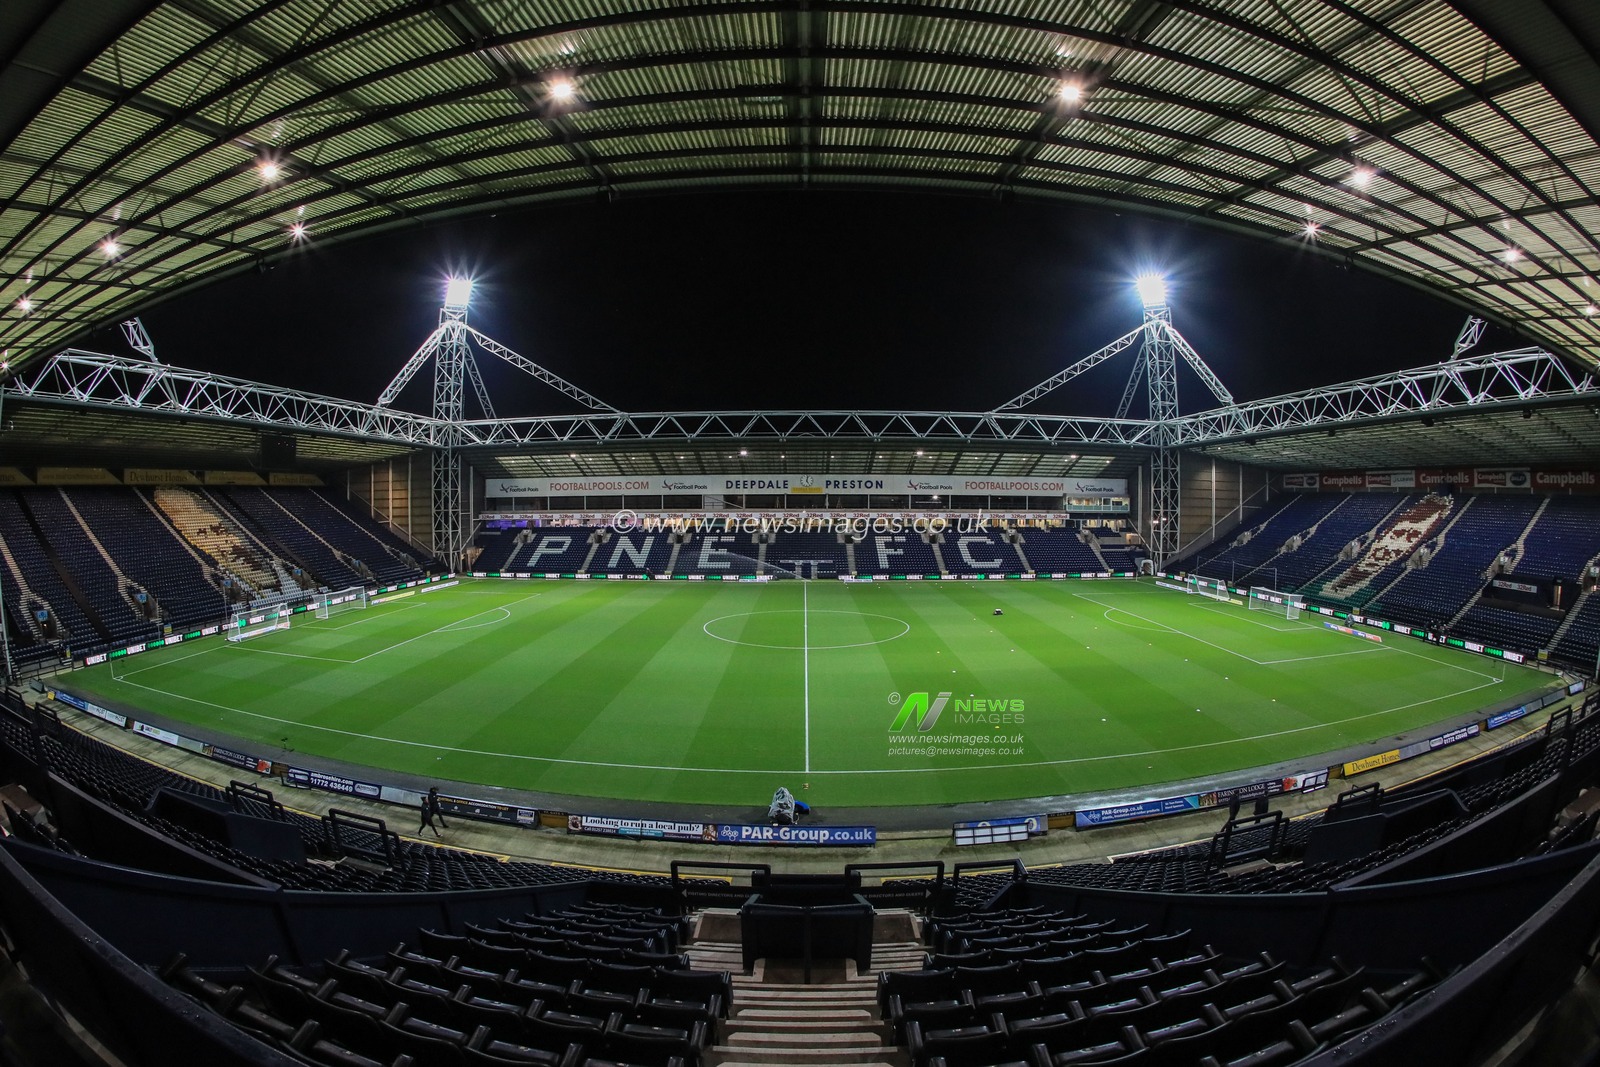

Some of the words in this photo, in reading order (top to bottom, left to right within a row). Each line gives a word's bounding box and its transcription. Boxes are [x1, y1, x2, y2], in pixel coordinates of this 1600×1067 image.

[129, 472, 163, 482] Dewhurst
[1322, 476, 1362, 486] Campbells
[1536, 472, 1595, 487] Campbells
[550, 481, 649, 491] FOOTBALLPOOLS.COM
[726, 480, 789, 489] DEEPDALE
[825, 480, 883, 489] PRESTON
[965, 481, 1064, 491] FOOTBALLPOOLS.COM
[527, 536, 572, 567] P
[608, 536, 655, 568] N
[698, 536, 735, 568] E
[875, 536, 906, 568] F
[957, 536, 1002, 568] C
[165, 634, 183, 645] UNIBET
[127, 644, 146, 655] UNIBET
[86, 653, 107, 665] UNIBET
[1352, 755, 1379, 772] Dewhurst
[1381, 752, 1400, 765] Homes
[1248, 783, 1265, 792] LODGE
[1102, 805, 1143, 816] PAR-Group.co.uk
[585, 816, 619, 827] Looking
[620, 819, 629, 827] to
[655, 821, 676, 830] local
[678, 824, 700, 833] pub?
[742, 826, 872, 843] PAR-Group.co.uk
